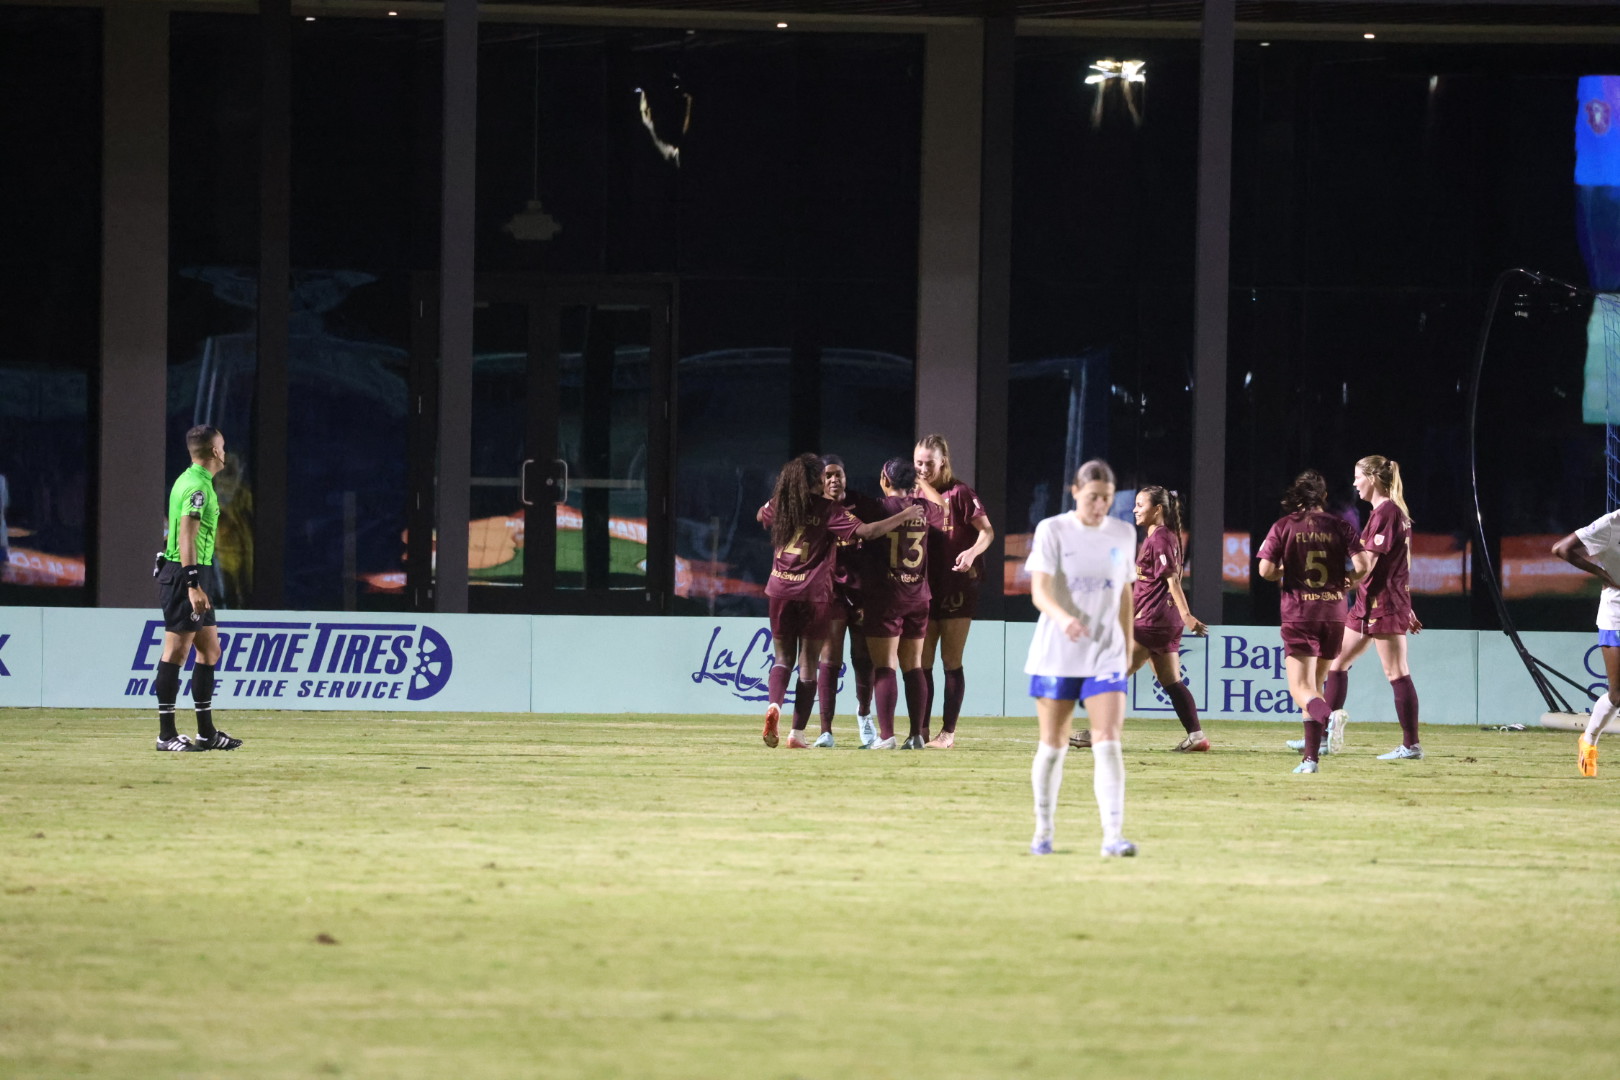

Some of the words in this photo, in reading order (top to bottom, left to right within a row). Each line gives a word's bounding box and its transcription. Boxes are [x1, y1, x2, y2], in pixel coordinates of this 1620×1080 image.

[886, 531, 926, 569] 13
[1295, 532, 1332, 544] FLYNN
[1303, 550, 1329, 589] 5
[307, 622, 417, 675] TIRES
[233, 679, 289, 697] TIRE
[297, 679, 404, 699] SERVICE
